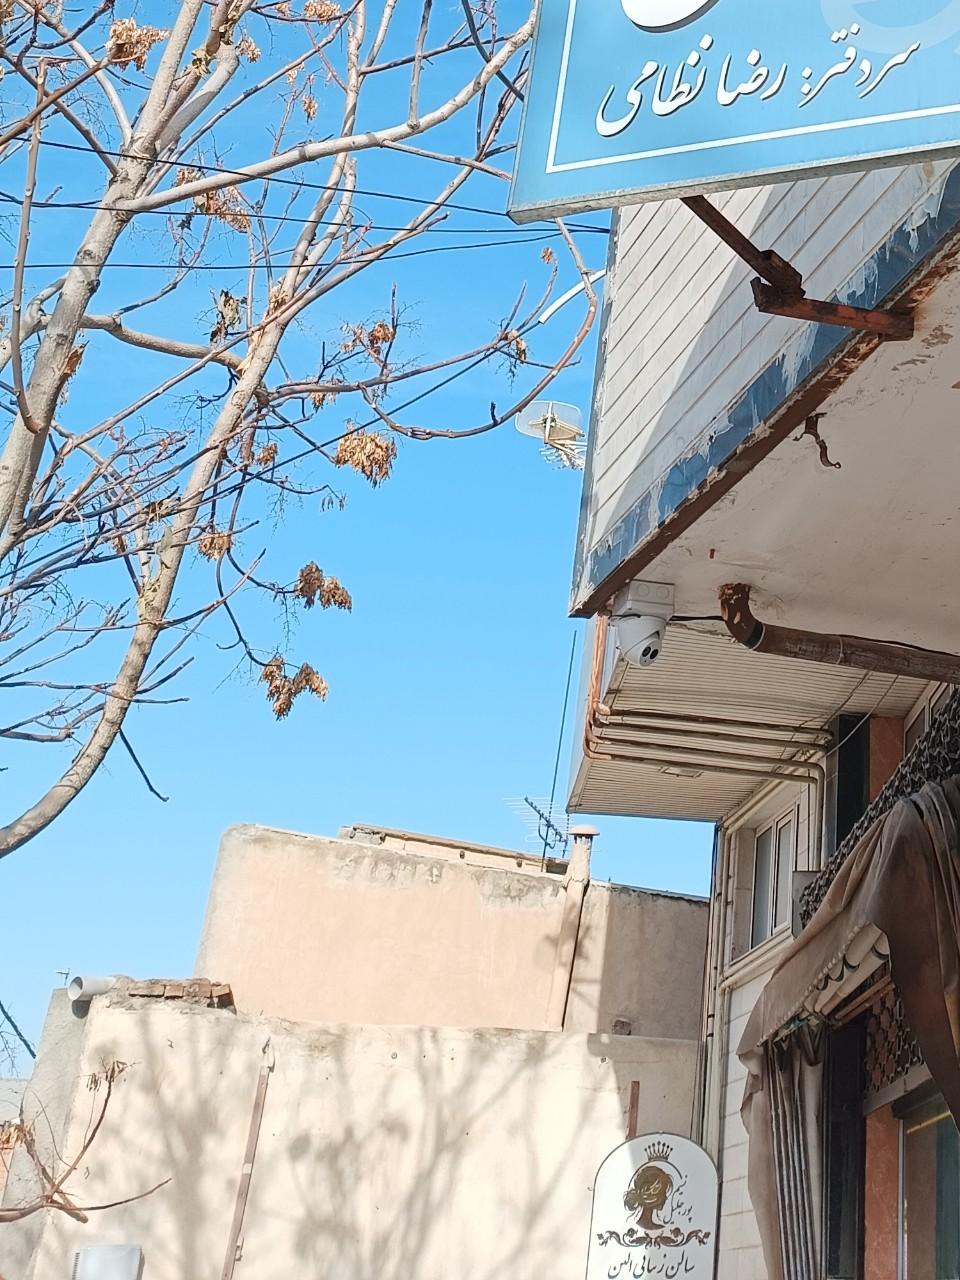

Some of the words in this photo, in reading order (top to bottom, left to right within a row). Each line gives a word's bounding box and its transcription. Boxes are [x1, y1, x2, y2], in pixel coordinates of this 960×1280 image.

[595, 33, 714, 138] نظامی
[715, 48, 789, 107] رضا
[665, 1250, 695, 1279] سالن
